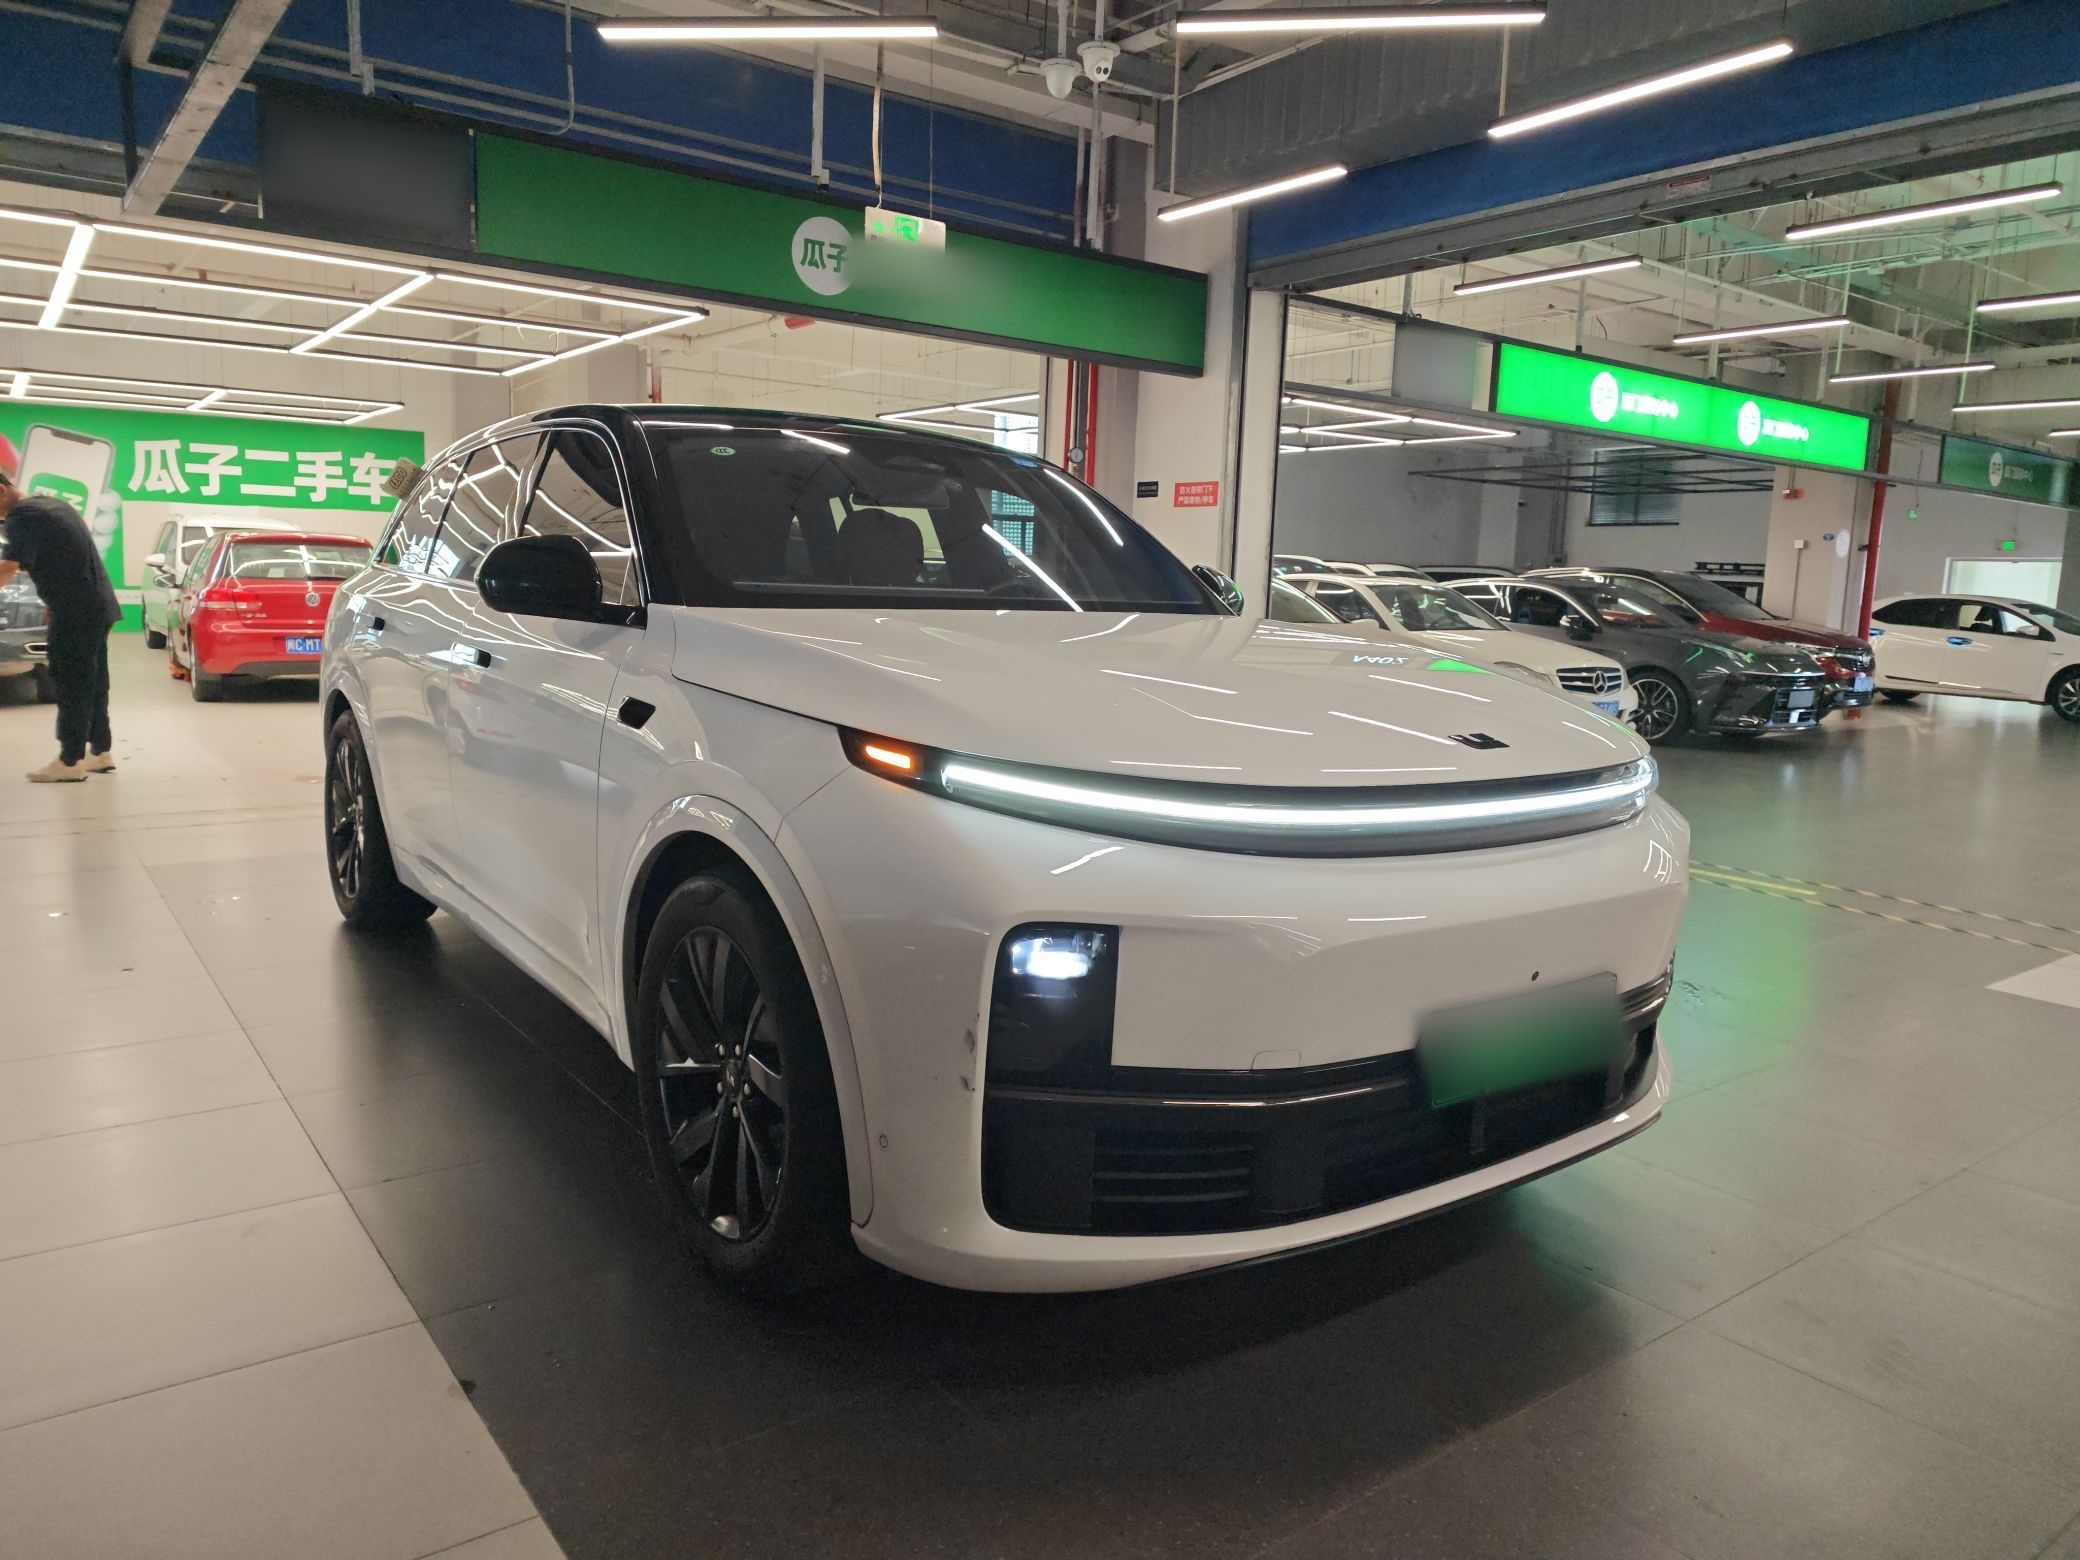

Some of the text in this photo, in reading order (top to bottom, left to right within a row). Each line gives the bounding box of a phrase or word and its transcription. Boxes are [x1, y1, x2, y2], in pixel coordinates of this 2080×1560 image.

[800, 238, 849, 273] 瓜子
[128, 439, 397, 505] 瓜子二手车
